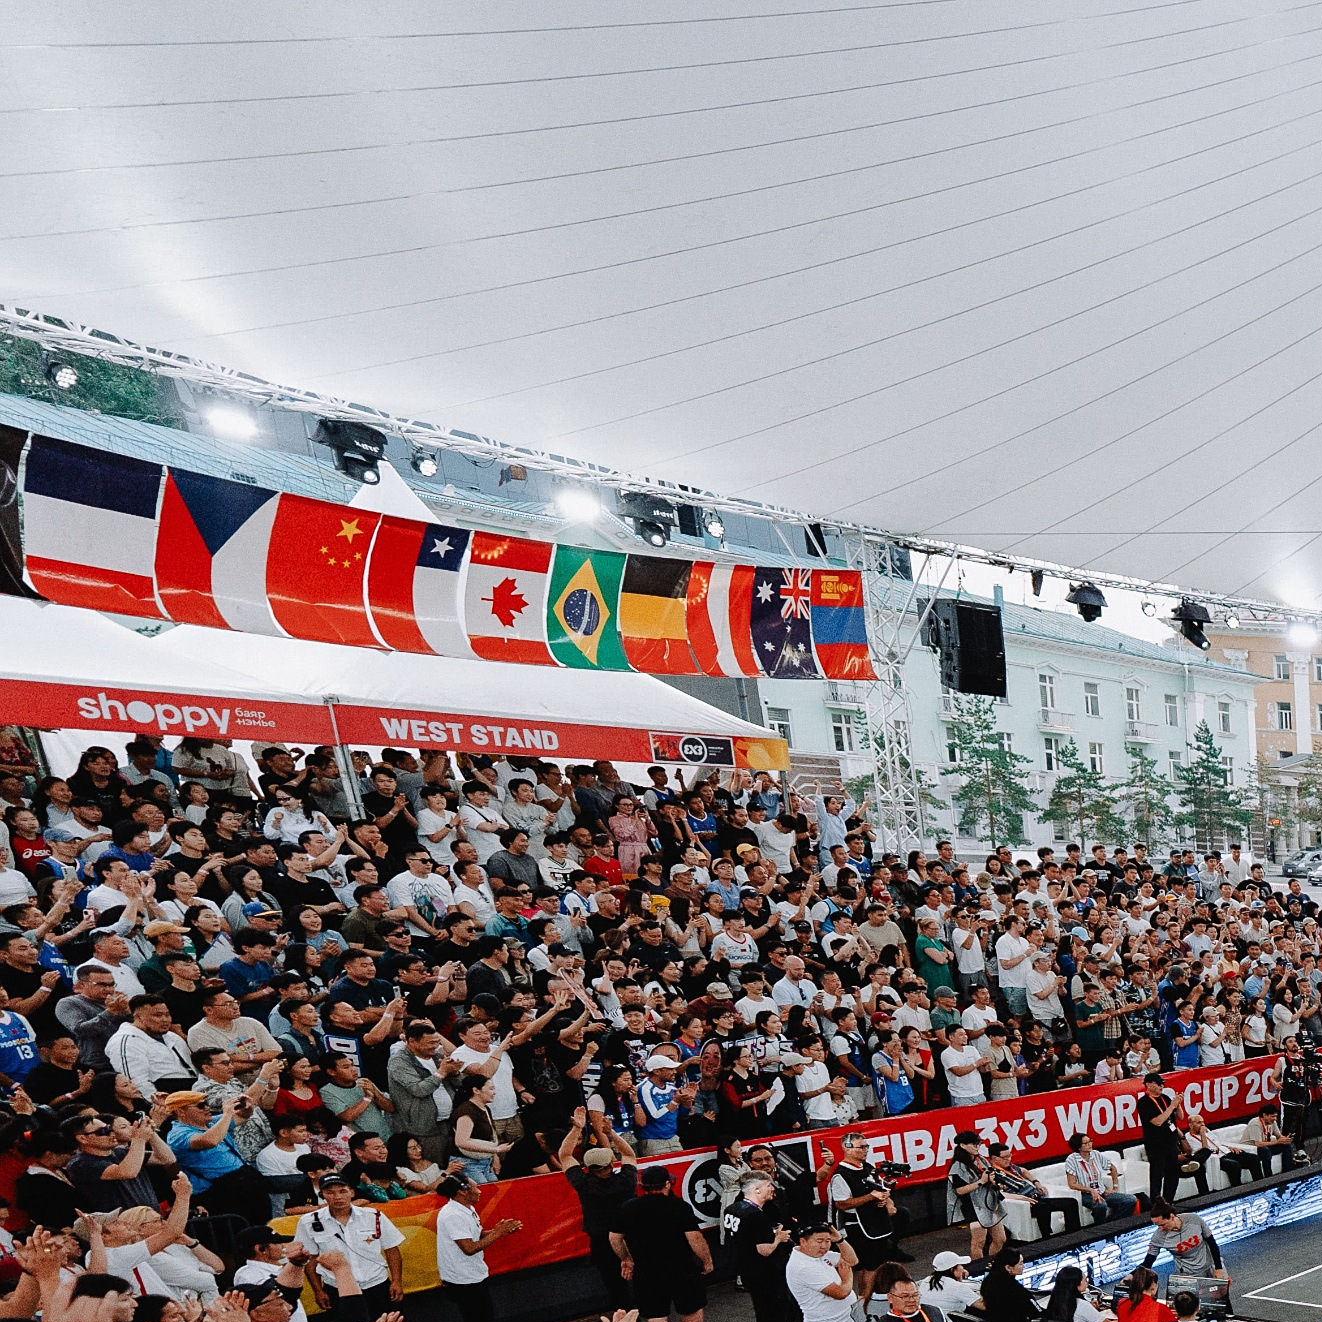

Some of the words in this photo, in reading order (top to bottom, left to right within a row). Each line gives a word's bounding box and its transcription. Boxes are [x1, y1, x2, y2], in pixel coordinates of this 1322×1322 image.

[77, 692, 230, 734] shoppy
[379, 717, 463, 744] WEST
[471, 724, 559, 751] STAND
[17, 1045, 34, 1060] 13
[865, 1123, 957, 1172] FIBA
[1184, 1075, 1239, 1117] CUP
[1244, 1068, 1281, 1105] 20
